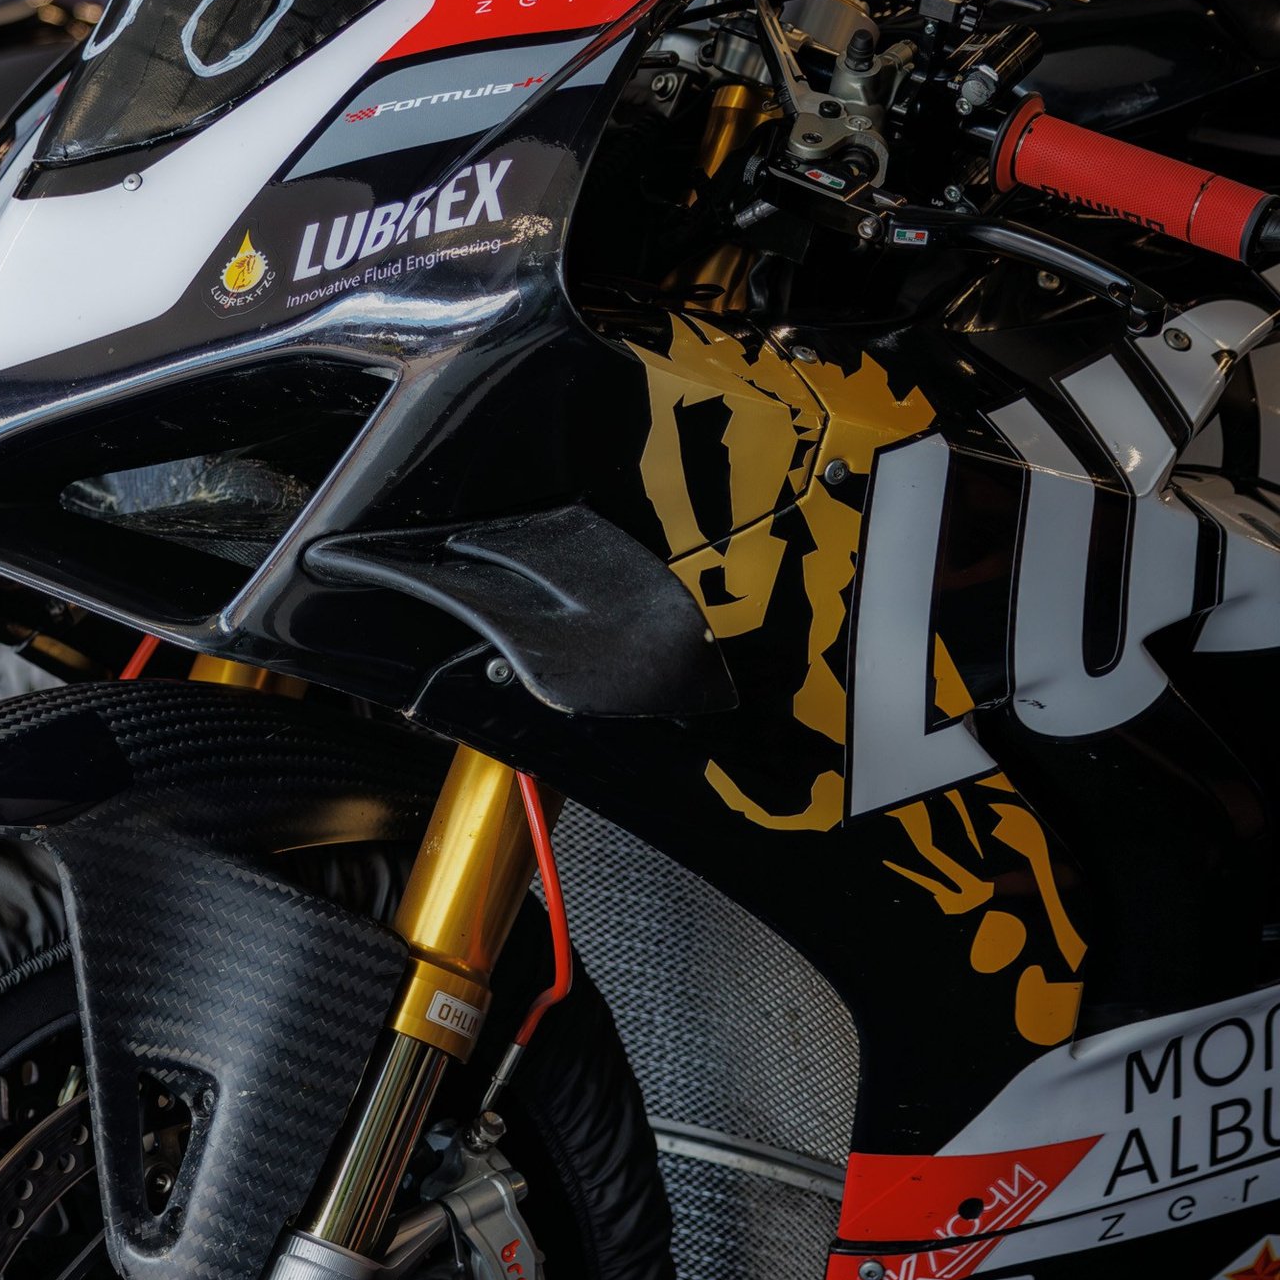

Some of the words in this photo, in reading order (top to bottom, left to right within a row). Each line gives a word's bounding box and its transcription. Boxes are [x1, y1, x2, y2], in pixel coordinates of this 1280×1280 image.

[373, 72, 549, 117] Formula-K
[293, 159, 513, 282] LUBREX
[209, 270, 277, 308] LUBREX-FZC
[286, 276, 361, 309] Innovative
[364, 262, 403, 283] Fluid
[407, 237, 503, 271] Engineering
